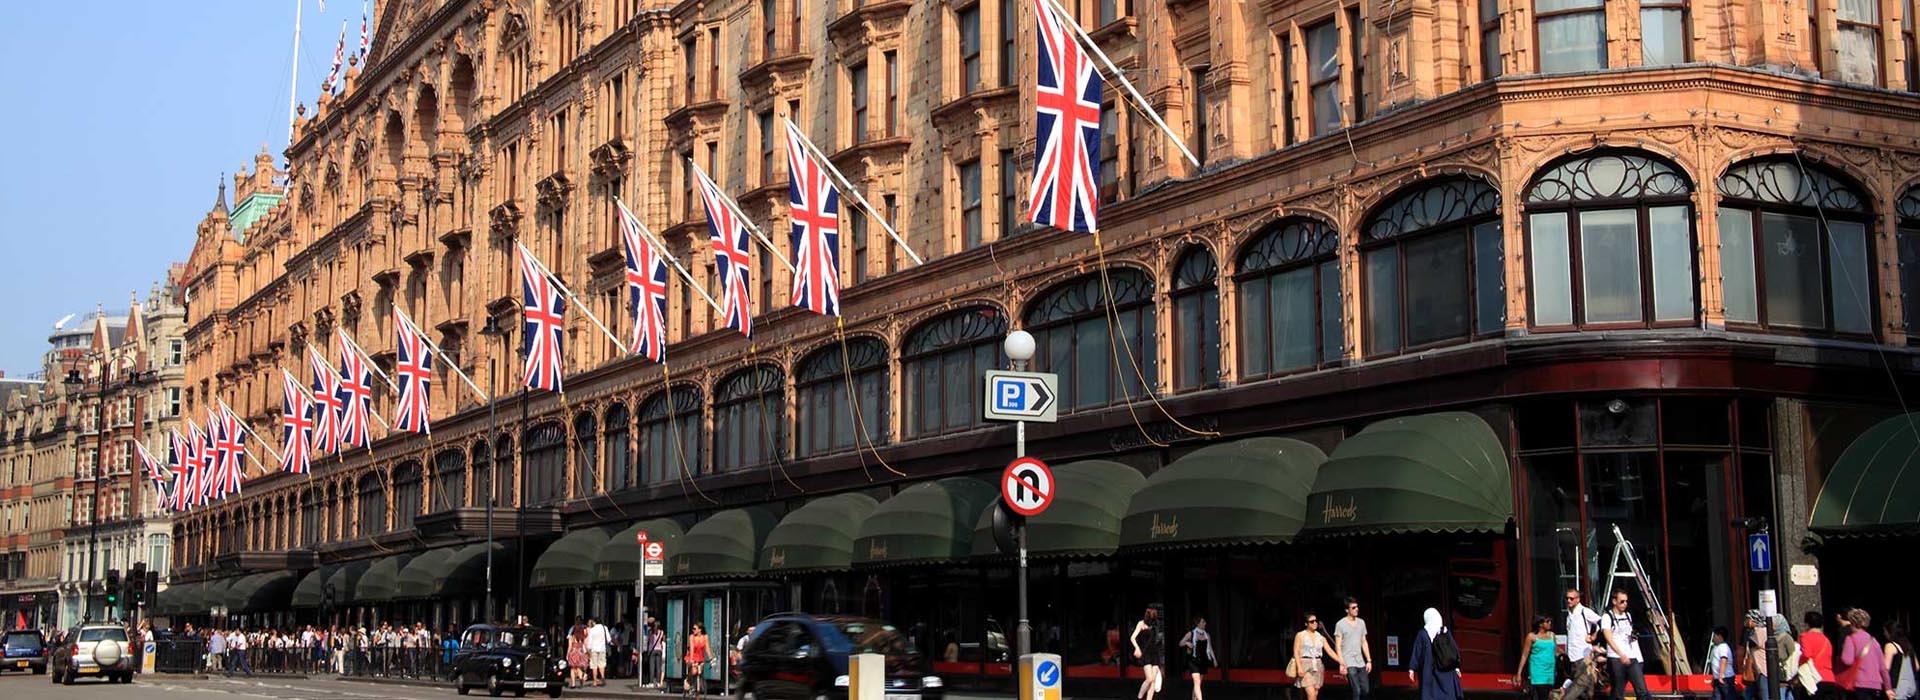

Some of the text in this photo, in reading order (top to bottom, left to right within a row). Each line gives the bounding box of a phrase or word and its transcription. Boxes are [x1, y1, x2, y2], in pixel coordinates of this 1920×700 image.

[1002, 384, 1020, 406] P
[1323, 494, 1358, 524] Harrods
[1150, 513, 1179, 539] Harrods
